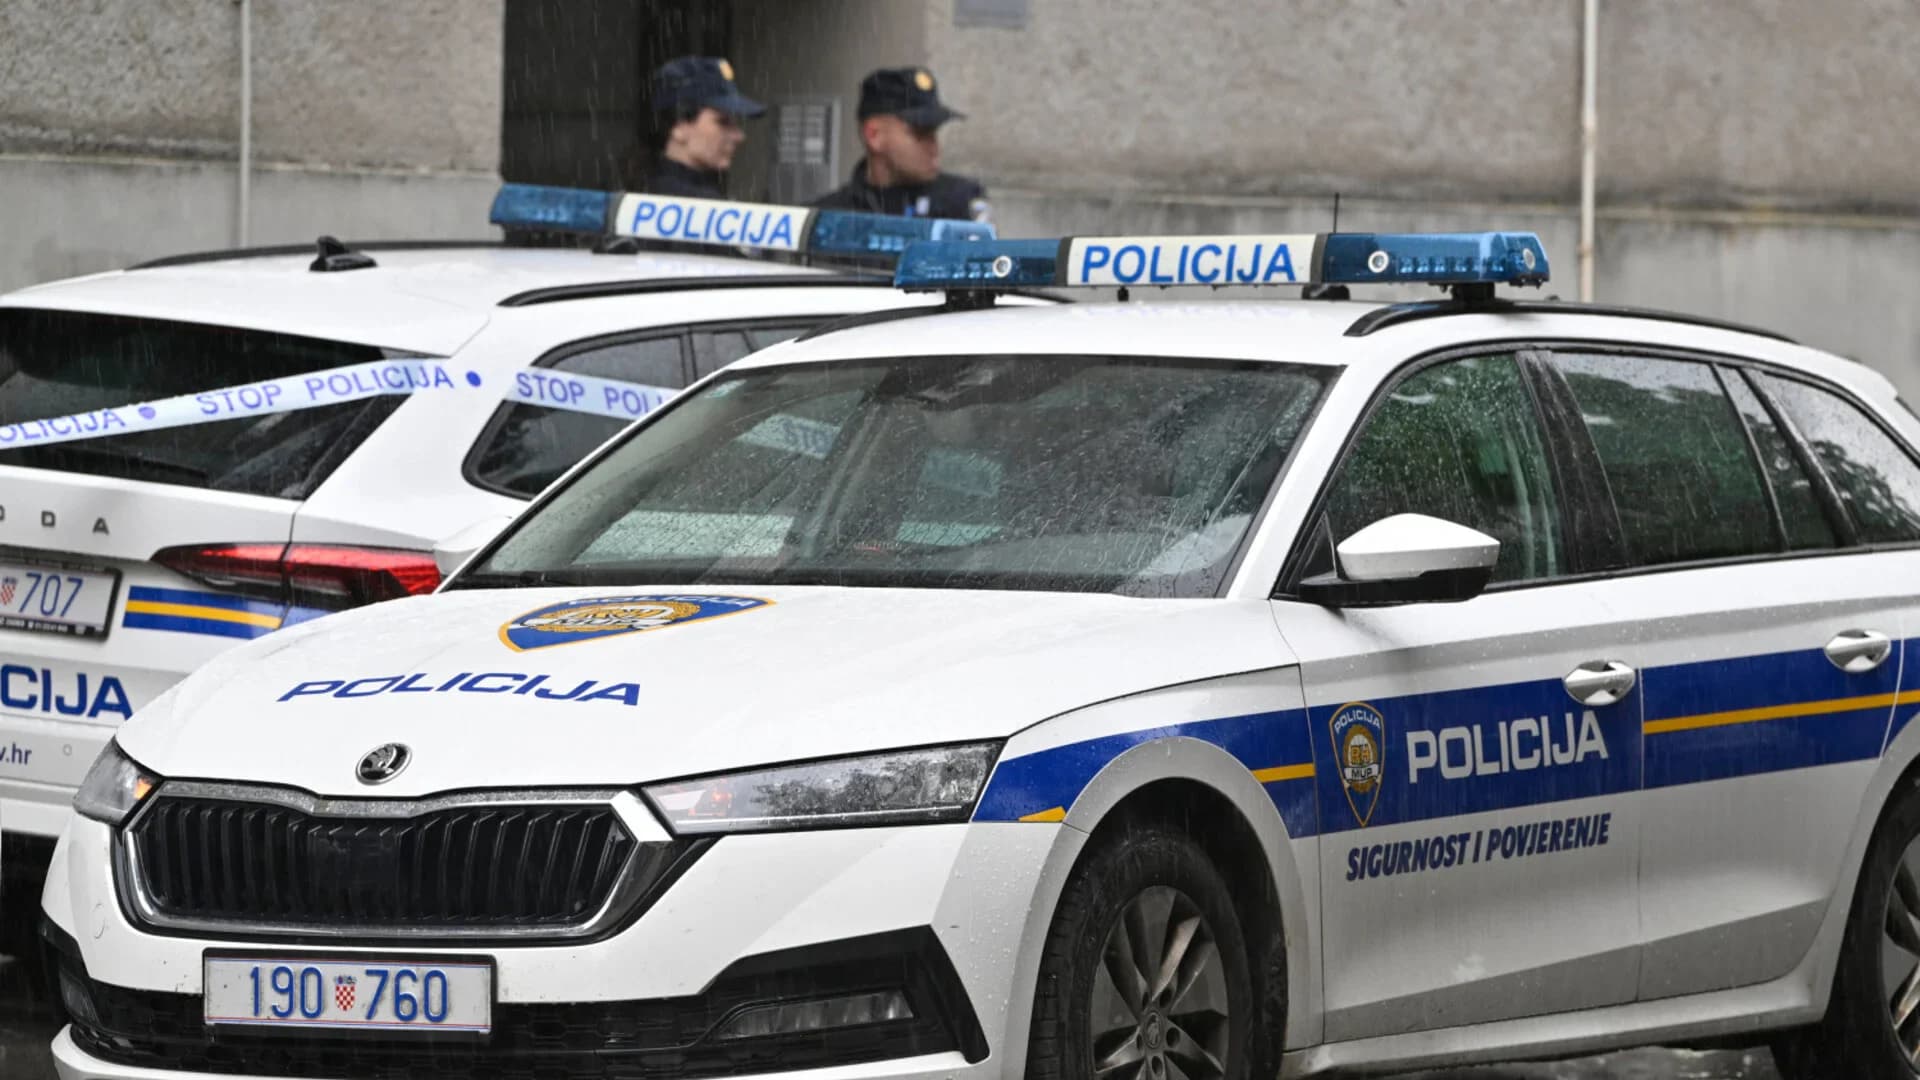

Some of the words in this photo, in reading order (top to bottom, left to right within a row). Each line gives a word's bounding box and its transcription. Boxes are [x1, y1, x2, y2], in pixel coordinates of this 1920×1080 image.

[631, 201, 793, 246] POLICIJA
[1080, 243, 1297, 284] POLICIJA
[196, 384, 283, 415] STOP
[308, 364, 454, 401] POLICIJA
[516, 372, 585, 405] STOP
[19, 572, 84, 618] 707
[0, 664, 133, 720] CIJA
[277, 672, 641, 706] POLICIJA
[1334, 710, 1381, 734] POLICIJA
[1406, 710, 1609, 784] POLICIJA
[1352, 767, 1373, 779] MUP
[1346, 832, 1471, 881] SIGURNOST
[1472, 831, 1484, 863] I
[1485, 812, 1612, 861] POVJERENJE
[250, 966, 323, 1018] 190
[364, 969, 448, 1022] 760
